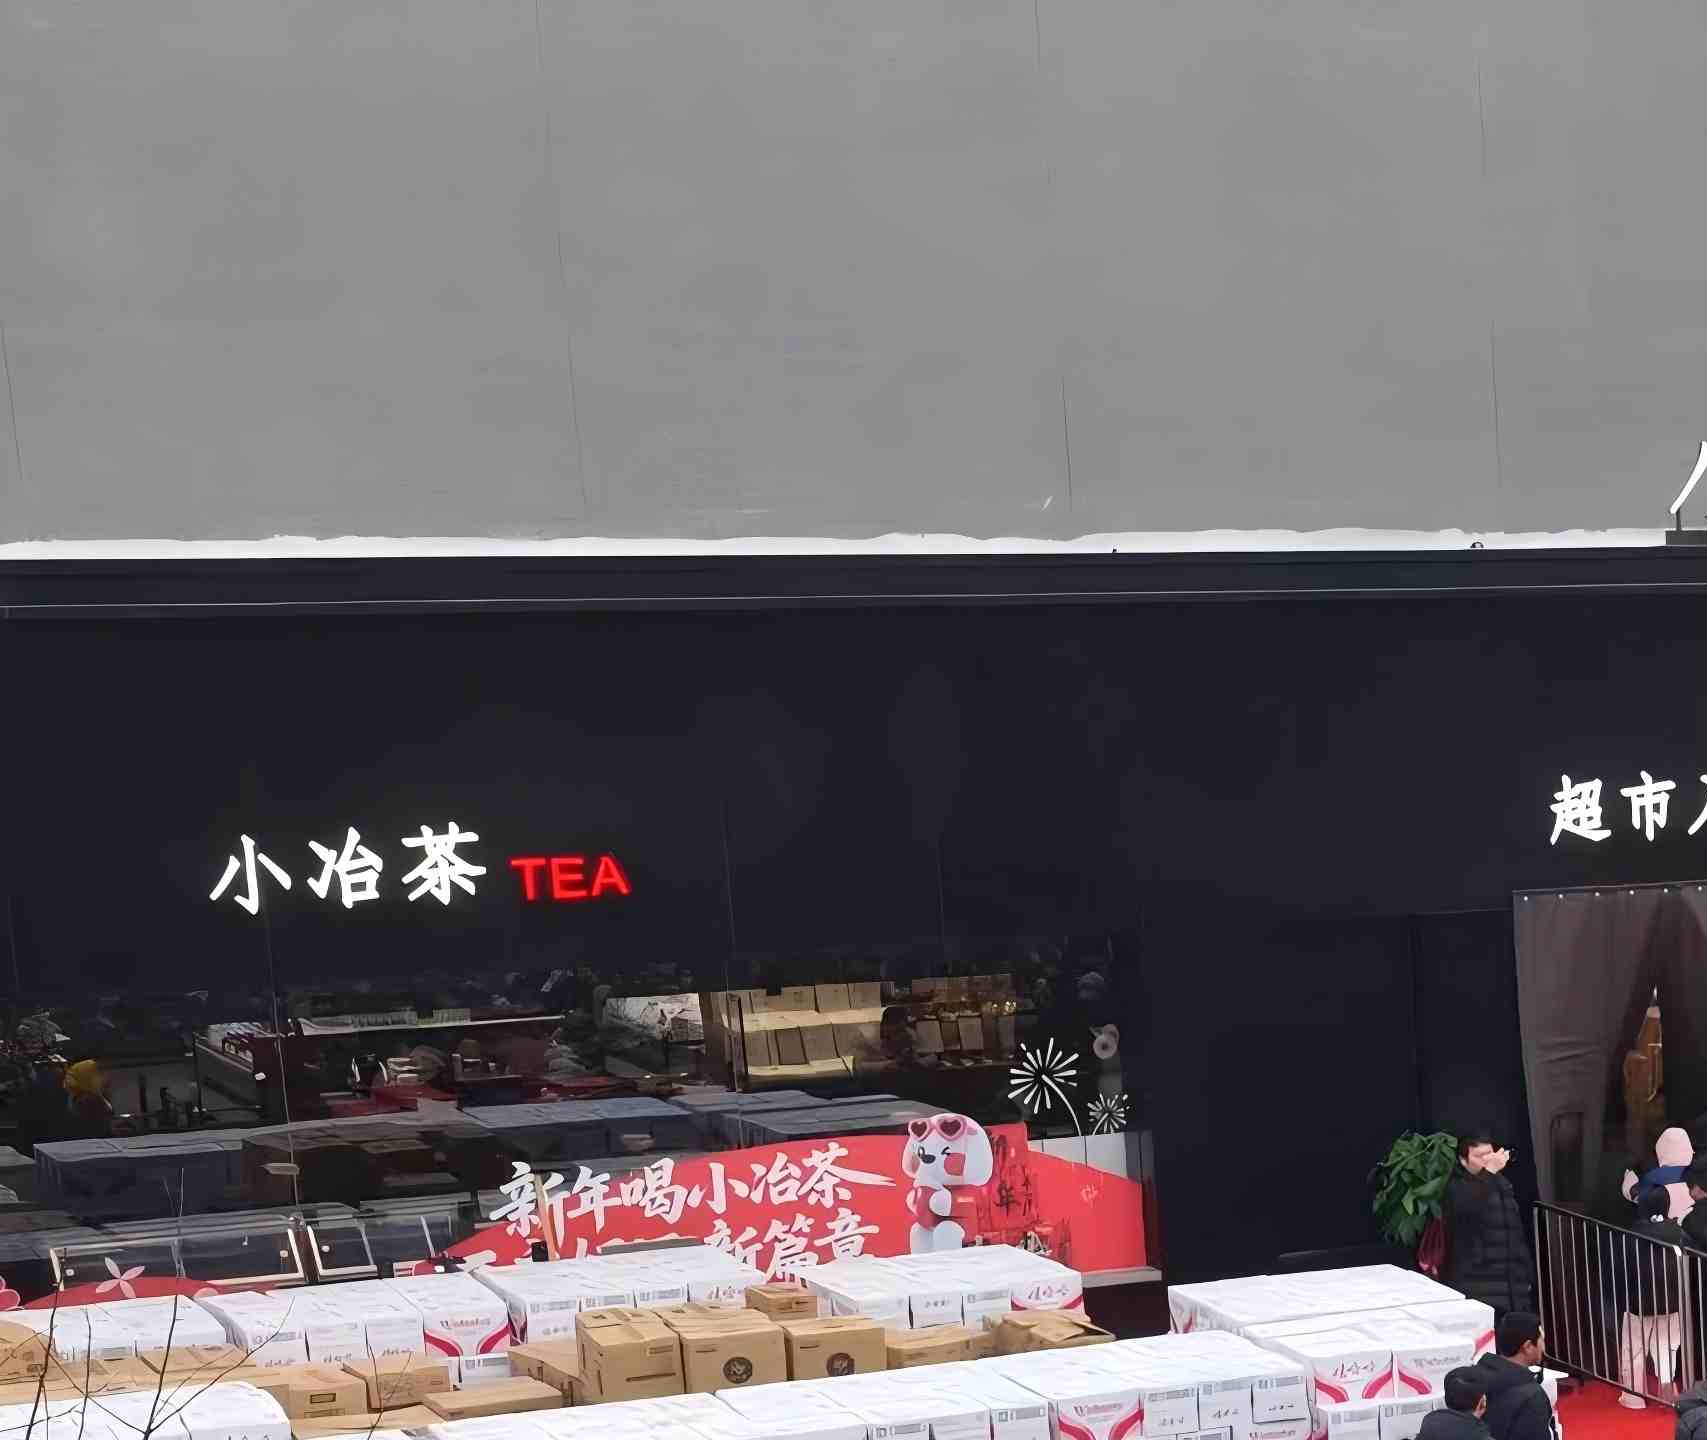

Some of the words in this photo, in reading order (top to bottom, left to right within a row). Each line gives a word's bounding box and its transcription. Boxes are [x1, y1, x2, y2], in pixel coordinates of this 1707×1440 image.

[209, 821, 487, 916] 小冶茶
[509, 853, 632, 902] TEA
